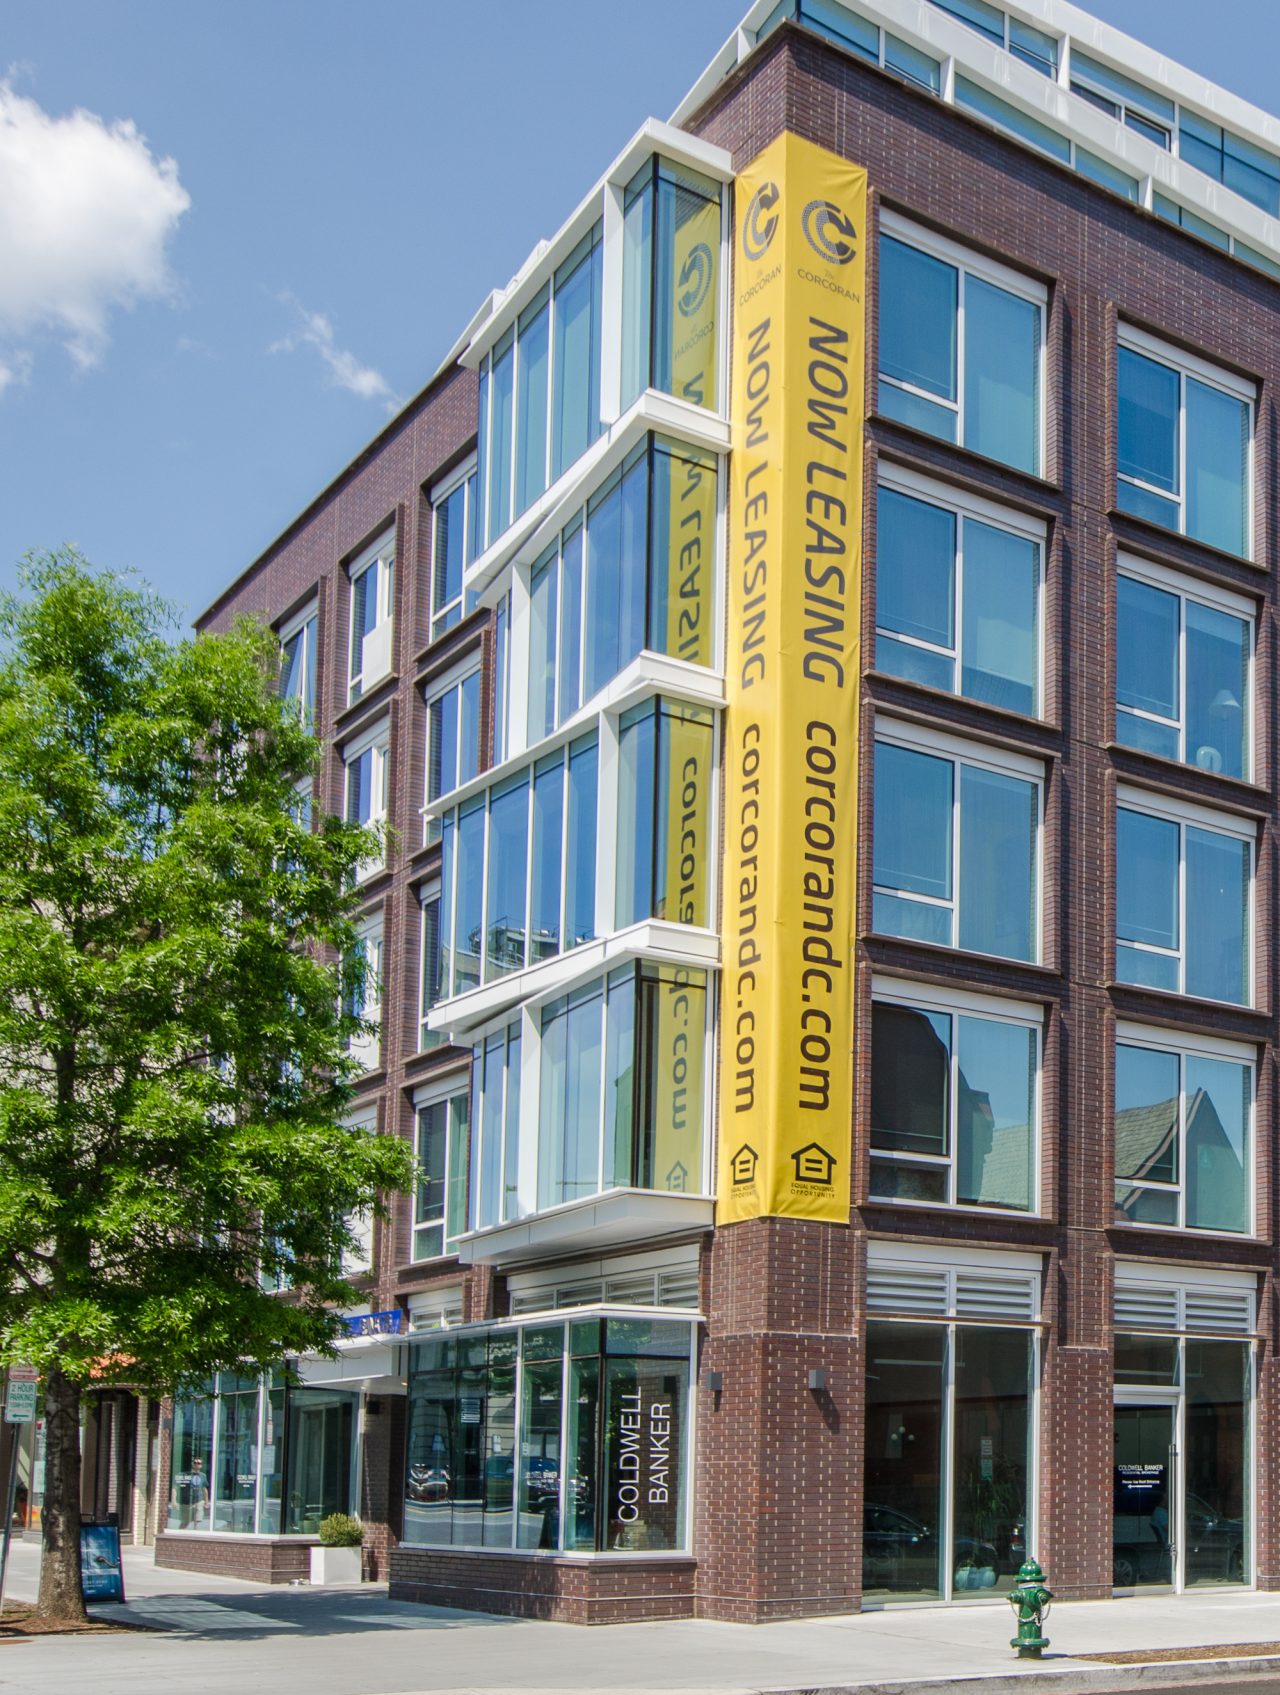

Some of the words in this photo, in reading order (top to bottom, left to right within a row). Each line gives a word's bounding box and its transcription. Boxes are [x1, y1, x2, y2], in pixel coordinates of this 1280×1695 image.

[739, 264, 782, 307] CORCORAN
[797, 268, 861, 304] CORCORAN
[746, 317, 771, 449] NOW
[807, 316, 849, 453] NOW
[741, 461, 768, 690] LEASING
[803, 460, 847, 689] LEASING
[735, 723, 762, 1114] corcorandc.com
[798, 720, 843, 1111] corcorandc.com
[790, 1188, 835, 1199] OPPORTUNITY
[791, 1182, 808, 1190] EQUAL
[810, 1184, 835, 1193] HOUSING
[618, 1386, 641, 1522] COLDWELL
[648, 1403, 671, 1503] BANKER
